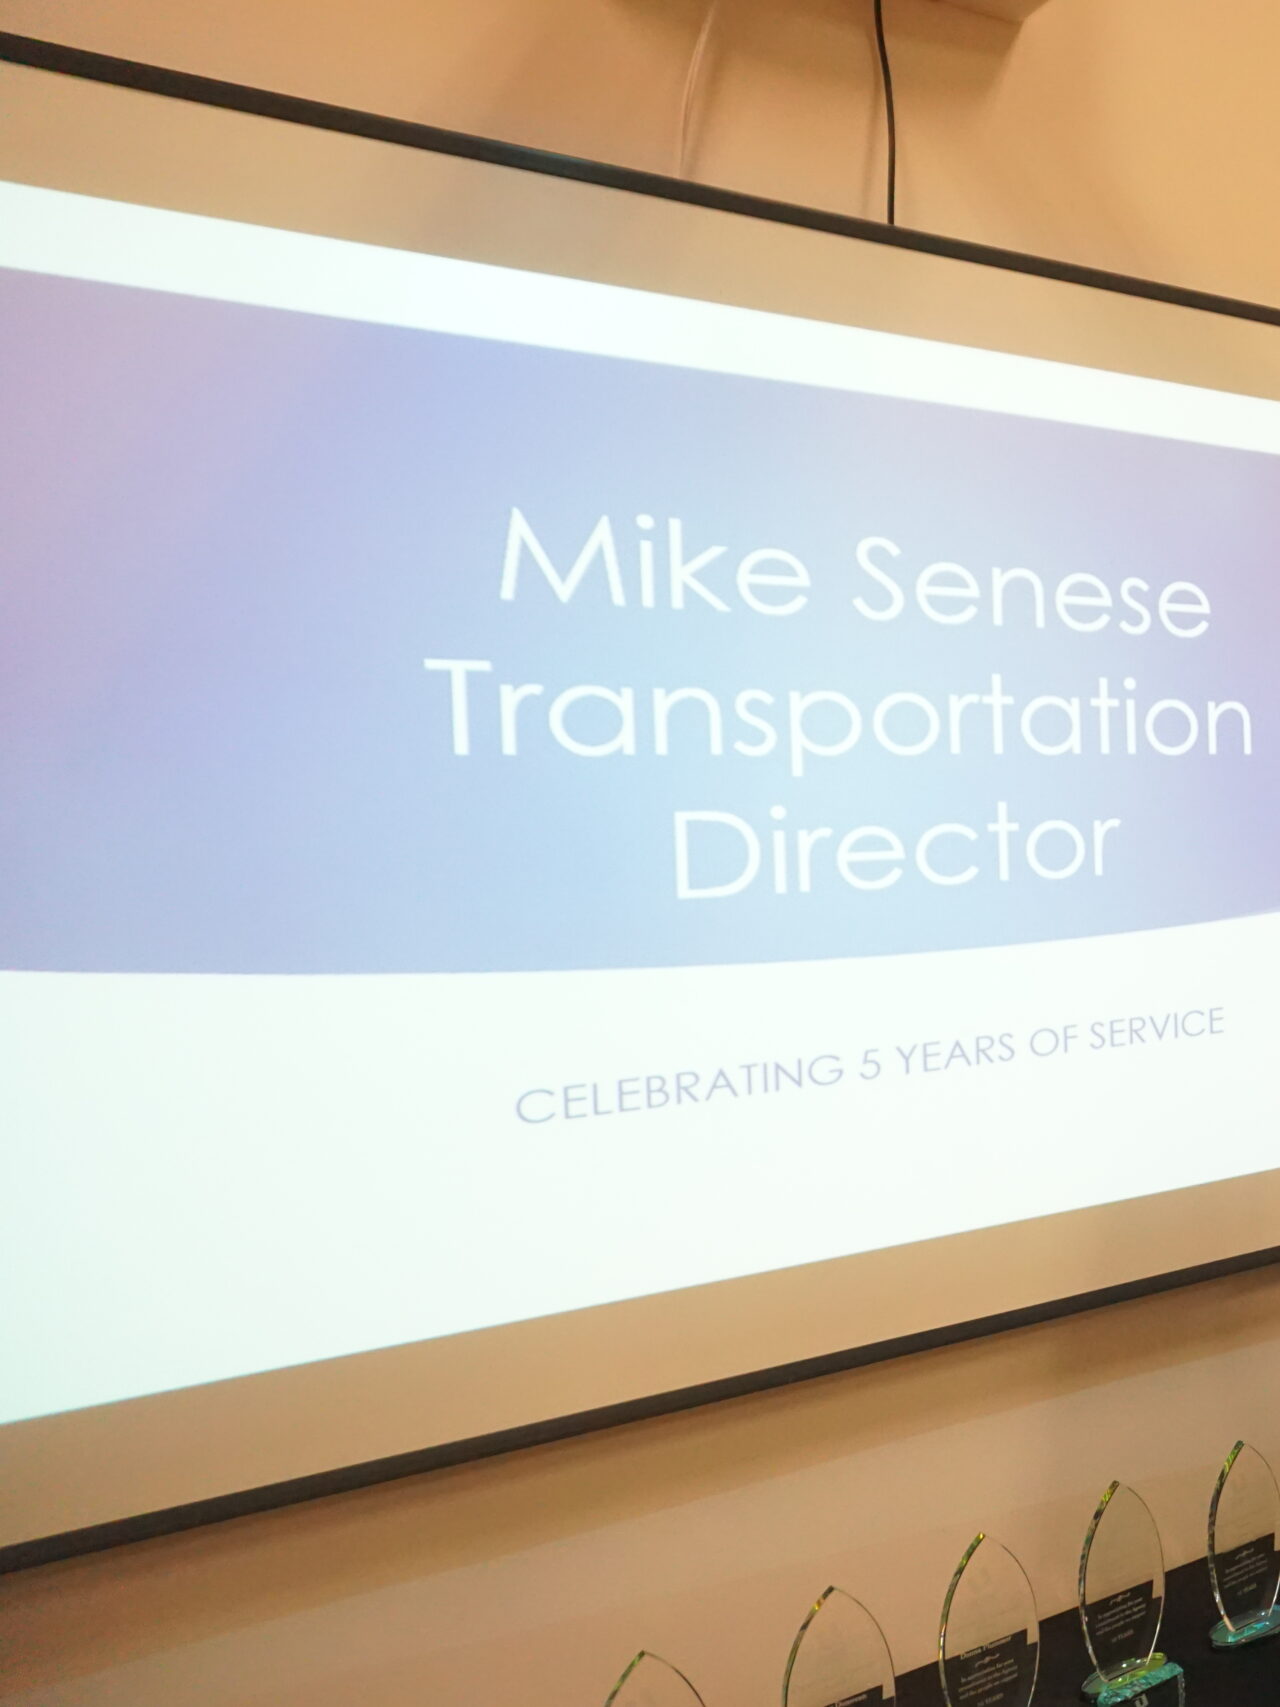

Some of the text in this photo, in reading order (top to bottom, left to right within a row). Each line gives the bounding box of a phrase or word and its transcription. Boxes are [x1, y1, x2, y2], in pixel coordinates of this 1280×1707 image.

[500, 507, 1211, 638] Mike Senese
[423, 658, 1253, 777] Transportation
[674, 801, 1121, 900] Director
[515, 1006, 1225, 1125] CELEBRATING 5 YEARS OF SERVICE
